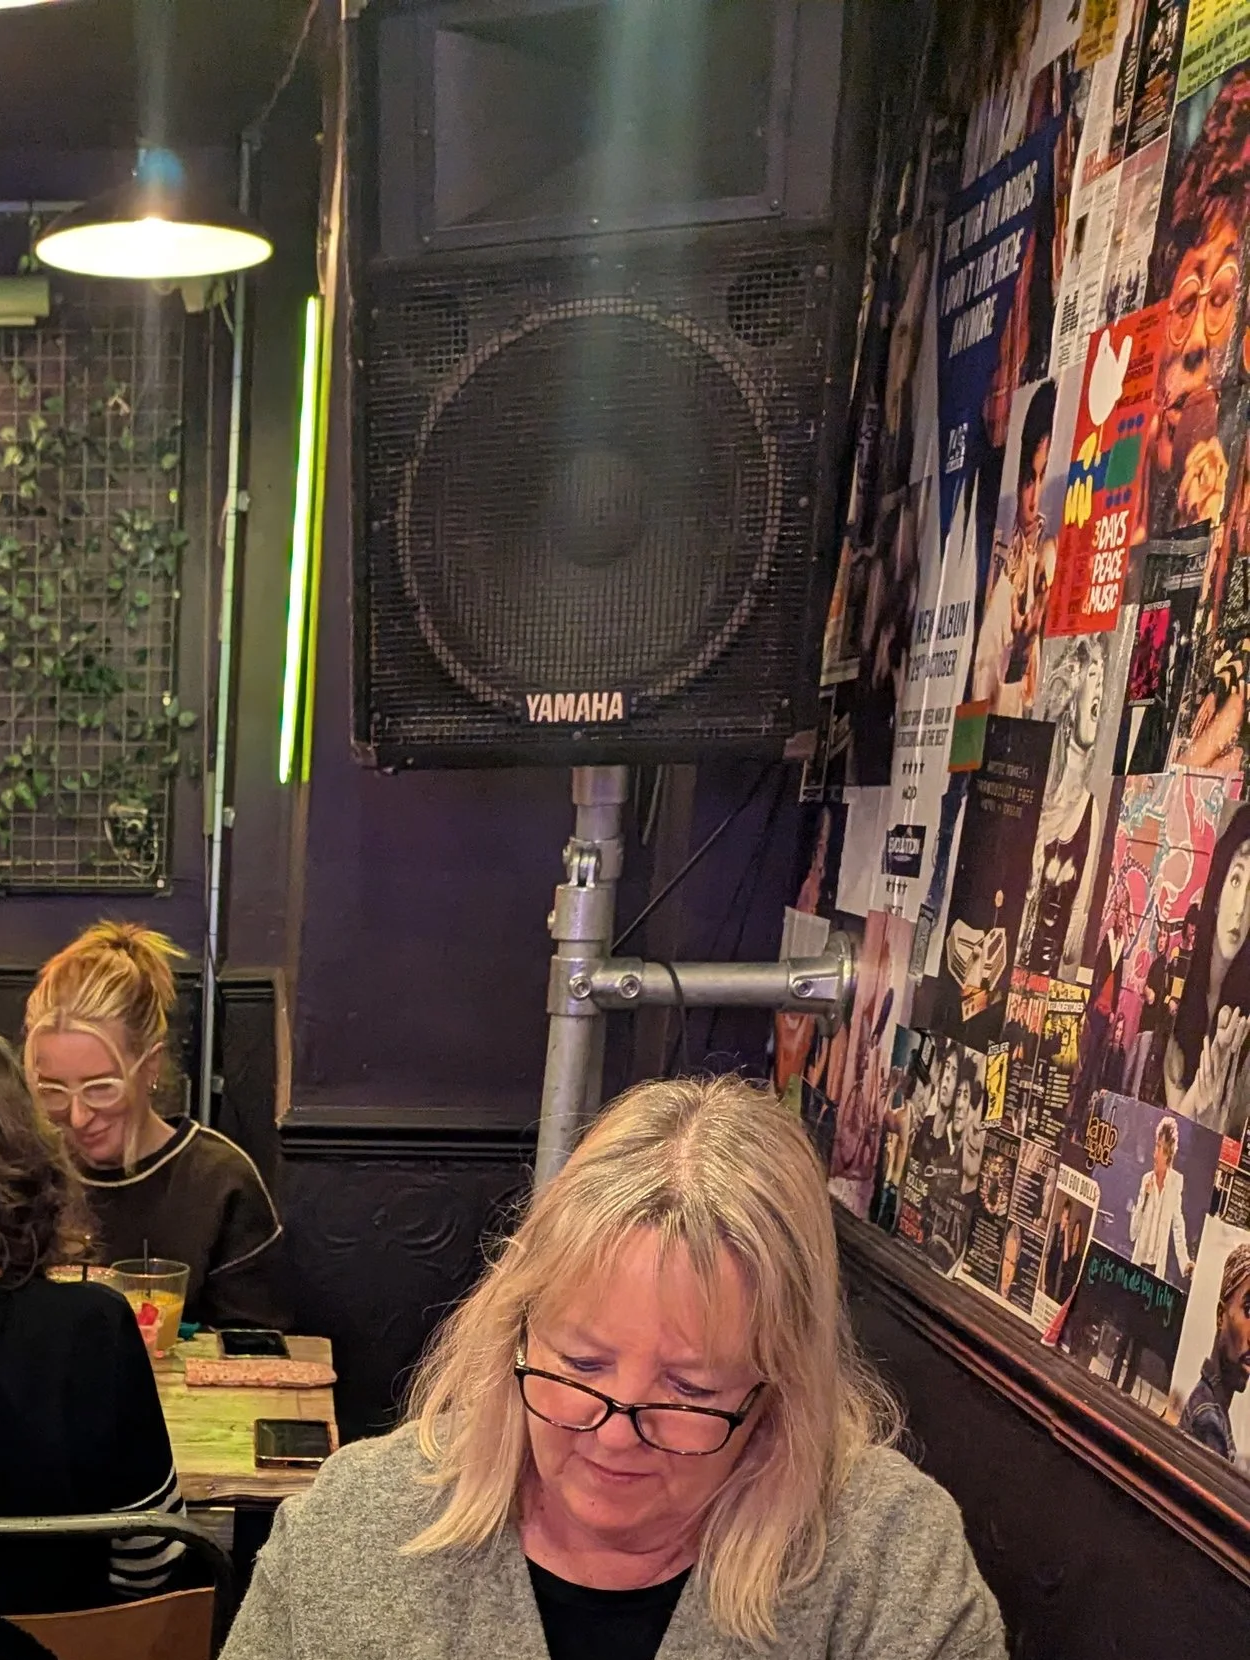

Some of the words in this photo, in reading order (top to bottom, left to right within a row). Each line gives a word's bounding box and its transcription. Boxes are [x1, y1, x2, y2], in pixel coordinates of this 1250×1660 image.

[974, 244, 998, 297] LIVE
[995, 227, 1025, 285] HERE
[1098, 510, 1129, 549] DAYS
[1091, 547, 1126, 585] PEACE
[1089, 582, 1120, 614] MUSIC
[937, 600, 970, 641] ALBUM
[526, 692, 624, 723] YAMAHA
[981, 1120, 1002, 1131] CHAOS
[1084, 1092, 1118, 1149] lamb
[1059, 1167, 1069, 1187] GOO
[1069, 1172, 1079, 1193] GOO
[1079, 1179, 1098, 1202] DOLLS
